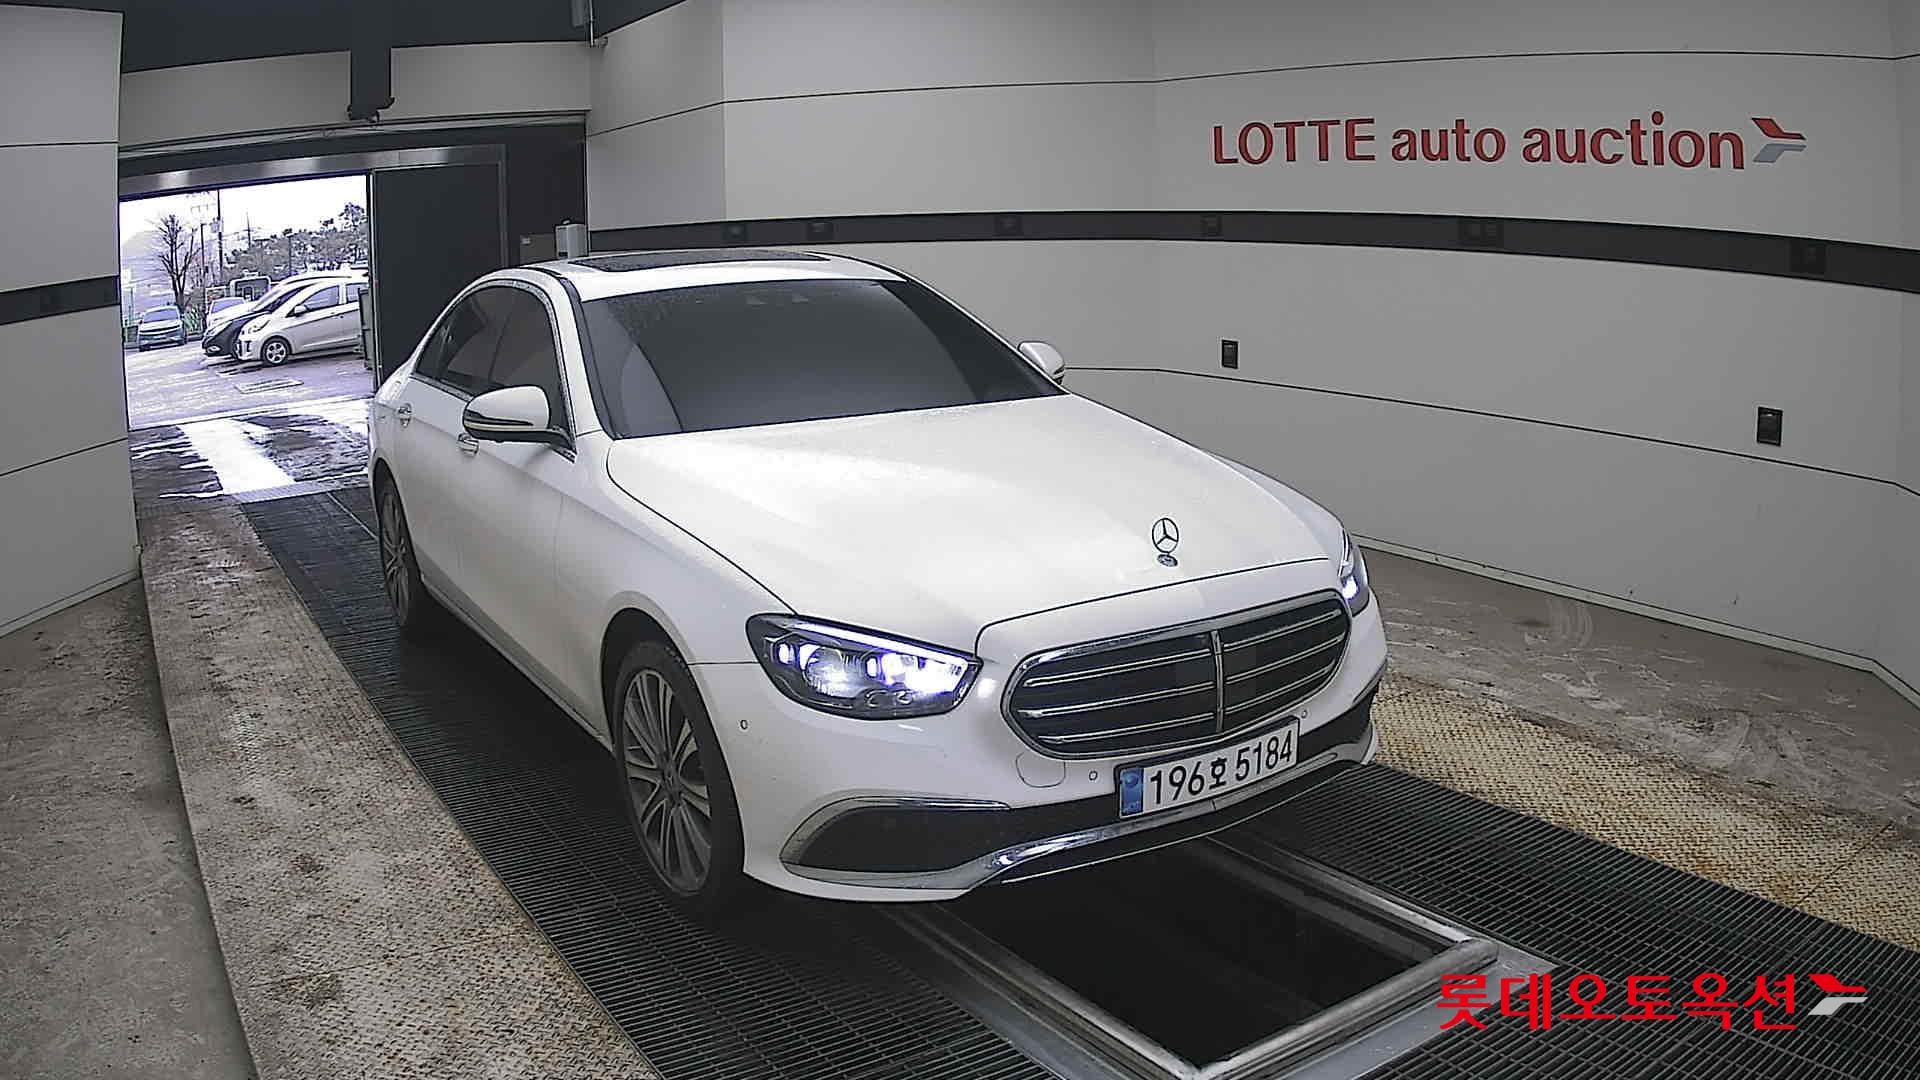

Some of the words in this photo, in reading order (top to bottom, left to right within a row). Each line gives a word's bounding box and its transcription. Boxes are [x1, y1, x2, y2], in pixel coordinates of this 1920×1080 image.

[1212, 117, 1376, 165] LOTTE
[1391, 119, 1506, 162] auto
[1522, 110, 1745, 170] auction
[1150, 757, 1228, 805] 196호
[1234, 730, 1292, 782] 5184
